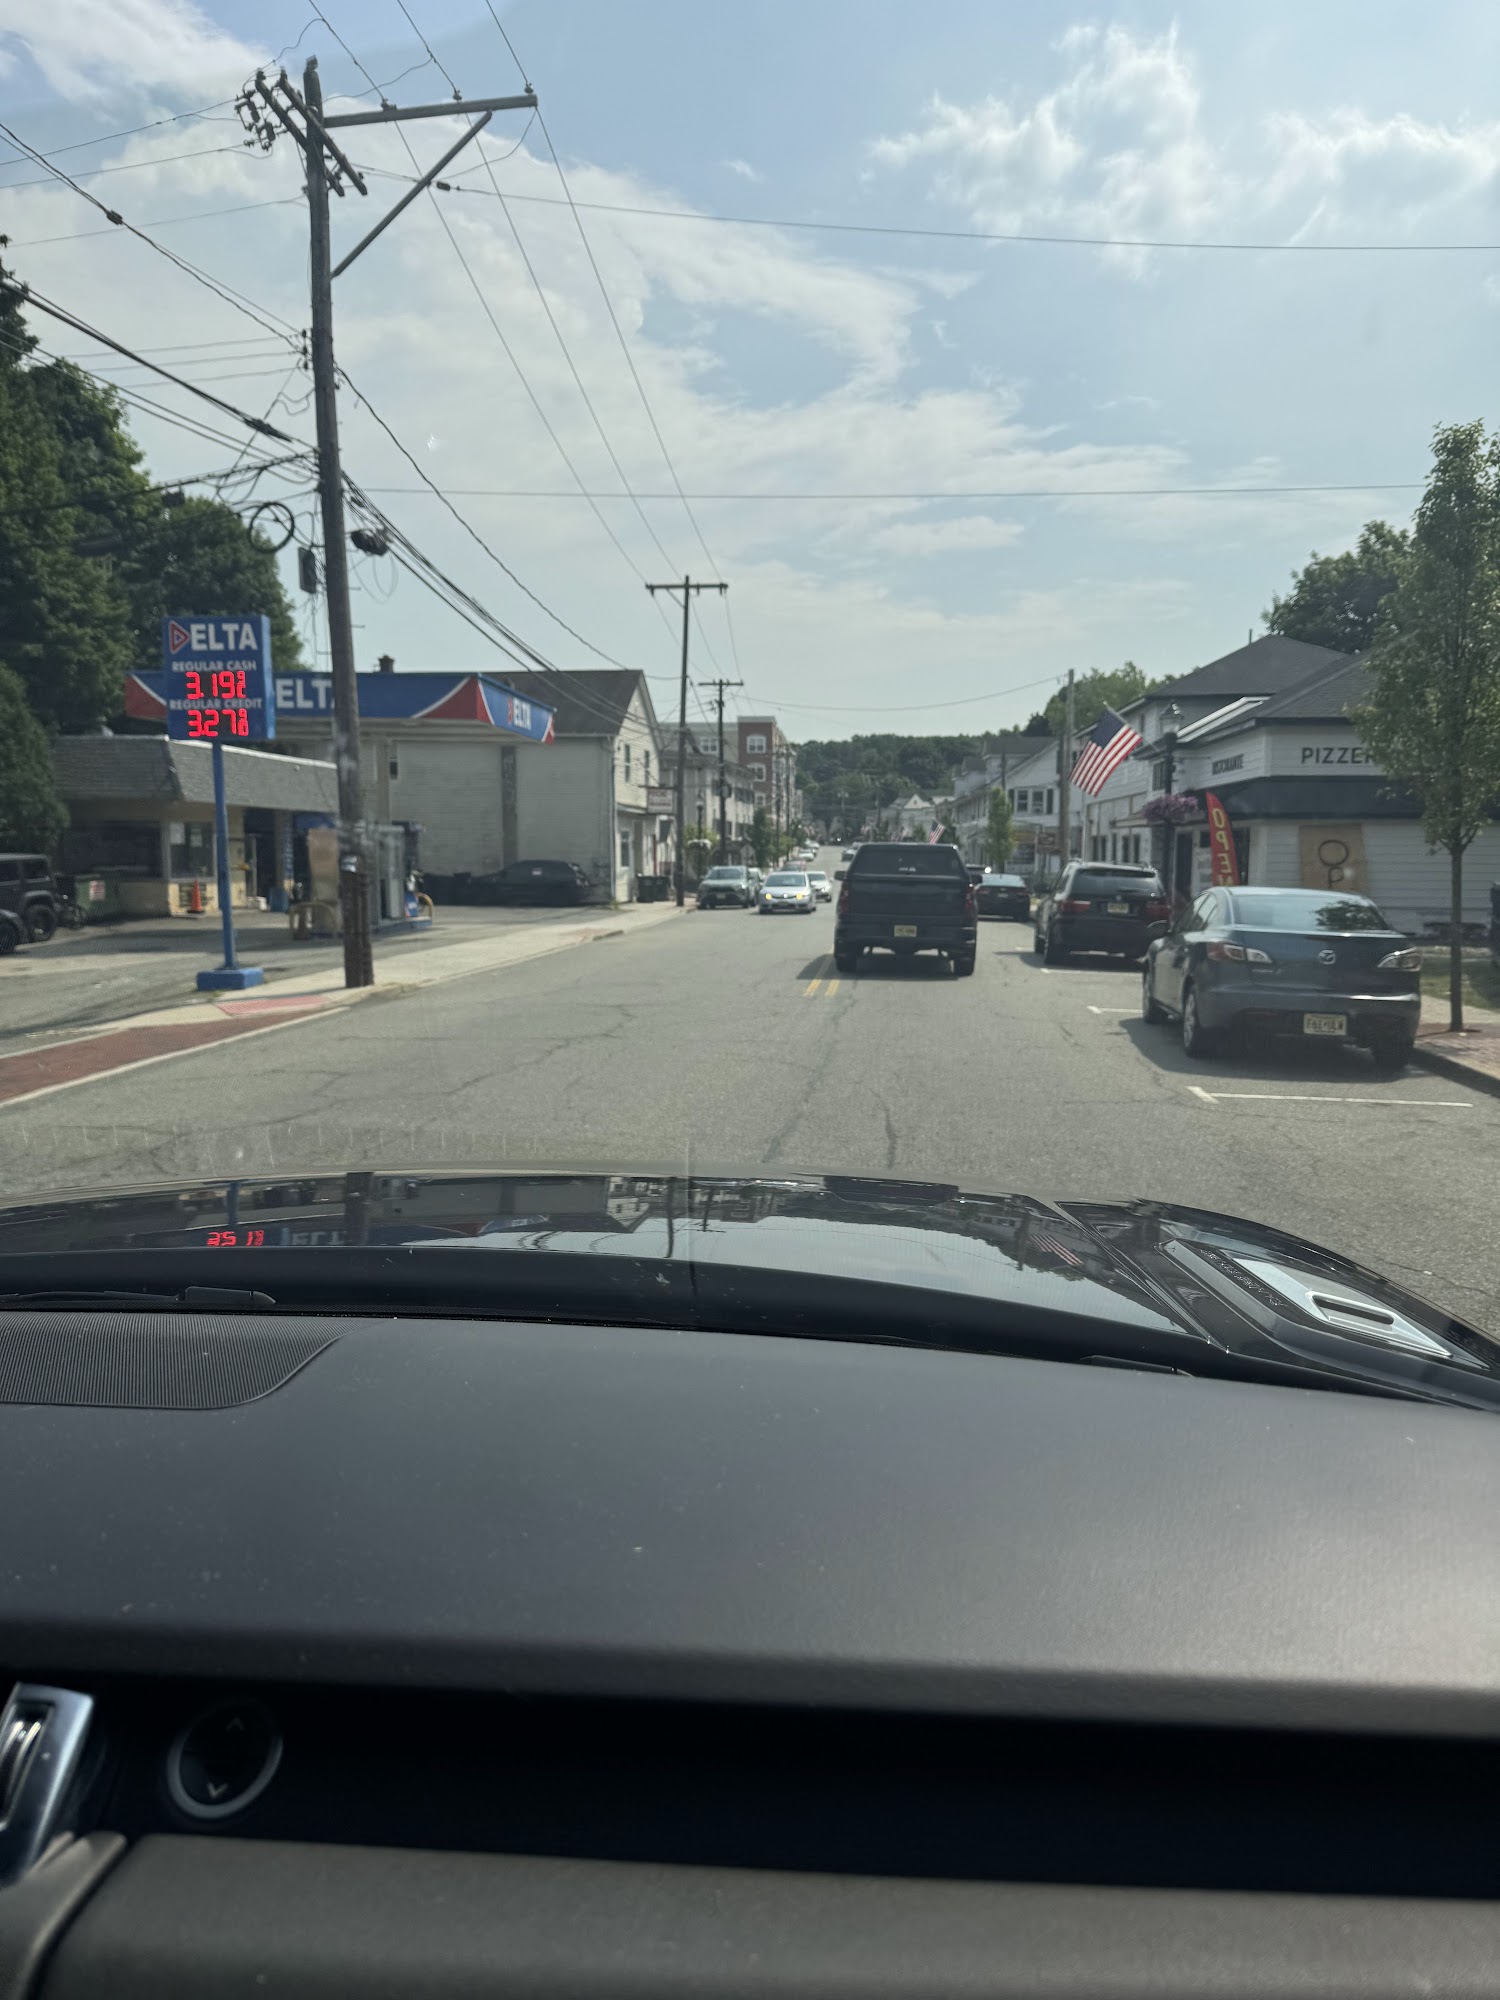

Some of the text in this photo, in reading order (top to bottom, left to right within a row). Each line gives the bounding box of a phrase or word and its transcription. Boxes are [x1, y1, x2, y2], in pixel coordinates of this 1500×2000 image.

[172, 660, 257, 672] REGULAR CASH
[169, 698, 262, 711] REGULAR CREDIT
